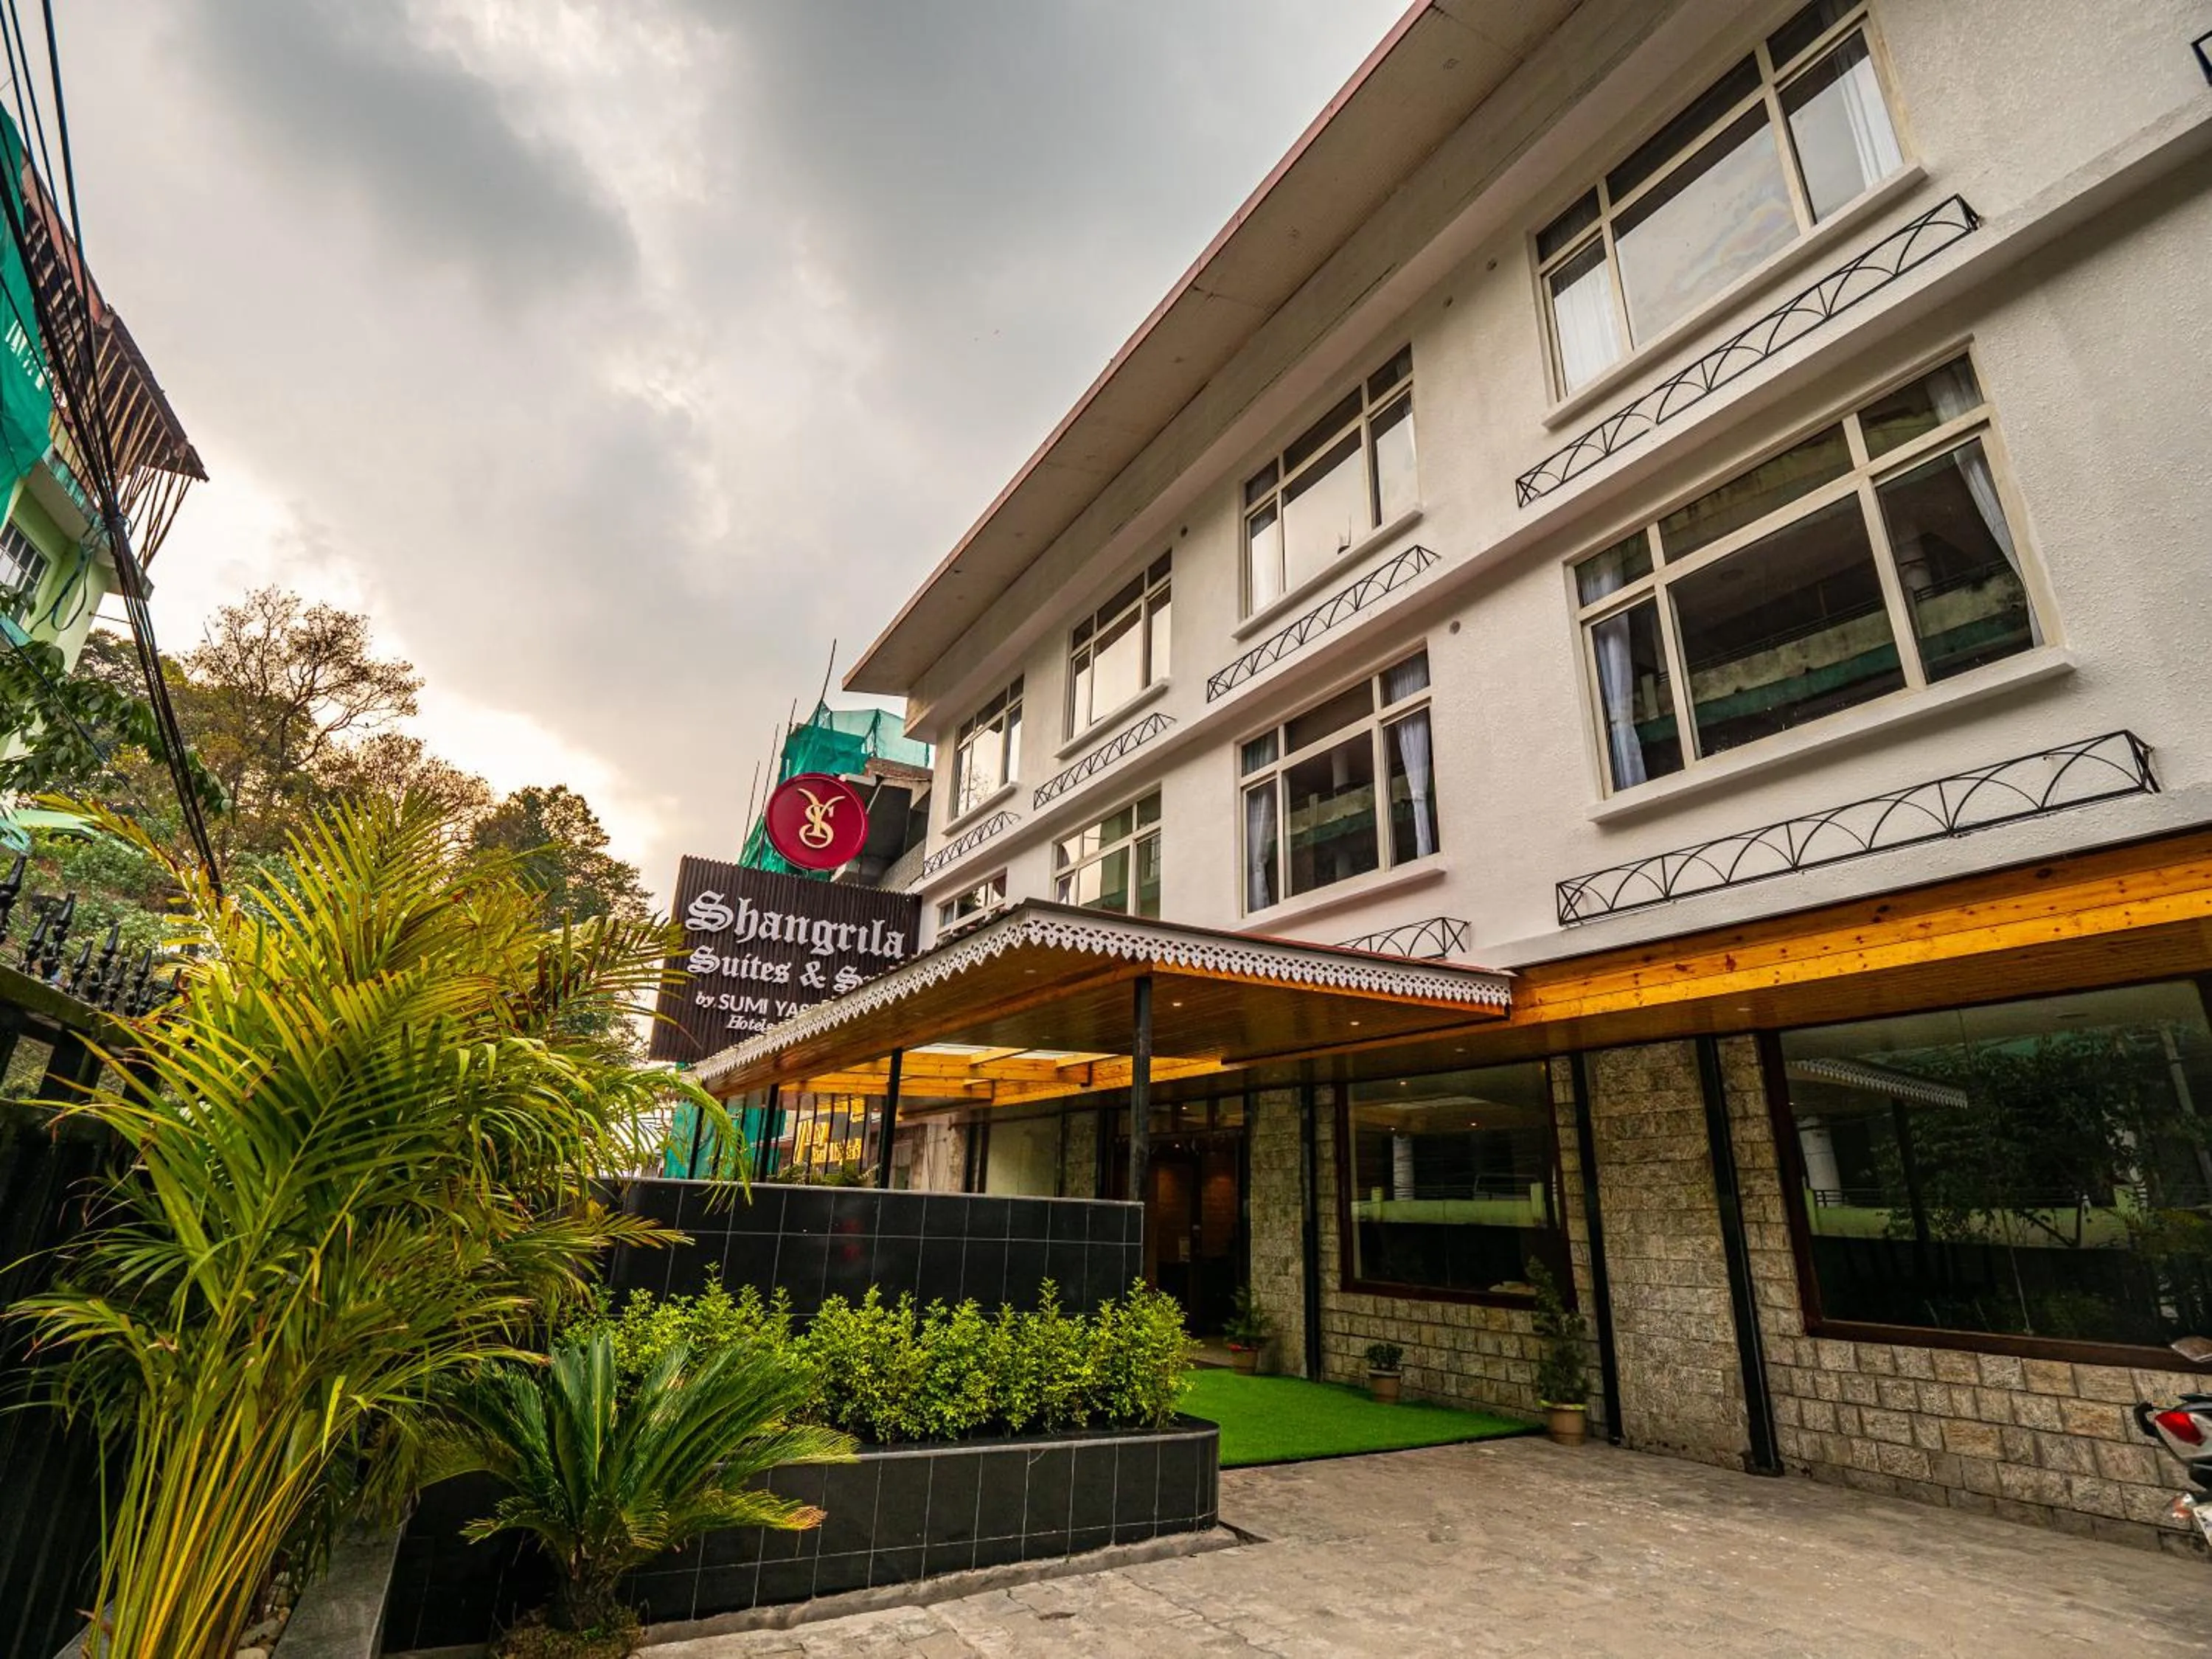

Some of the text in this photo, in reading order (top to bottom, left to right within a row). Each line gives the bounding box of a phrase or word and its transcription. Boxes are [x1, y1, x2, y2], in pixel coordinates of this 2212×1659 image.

[685, 890, 905, 959] Shangrila
[686, 945, 792, 984] Suites
[799, 961, 827, 989] &
[695, 991, 714, 1008] by
[718, 993, 769, 1015] SUMI
